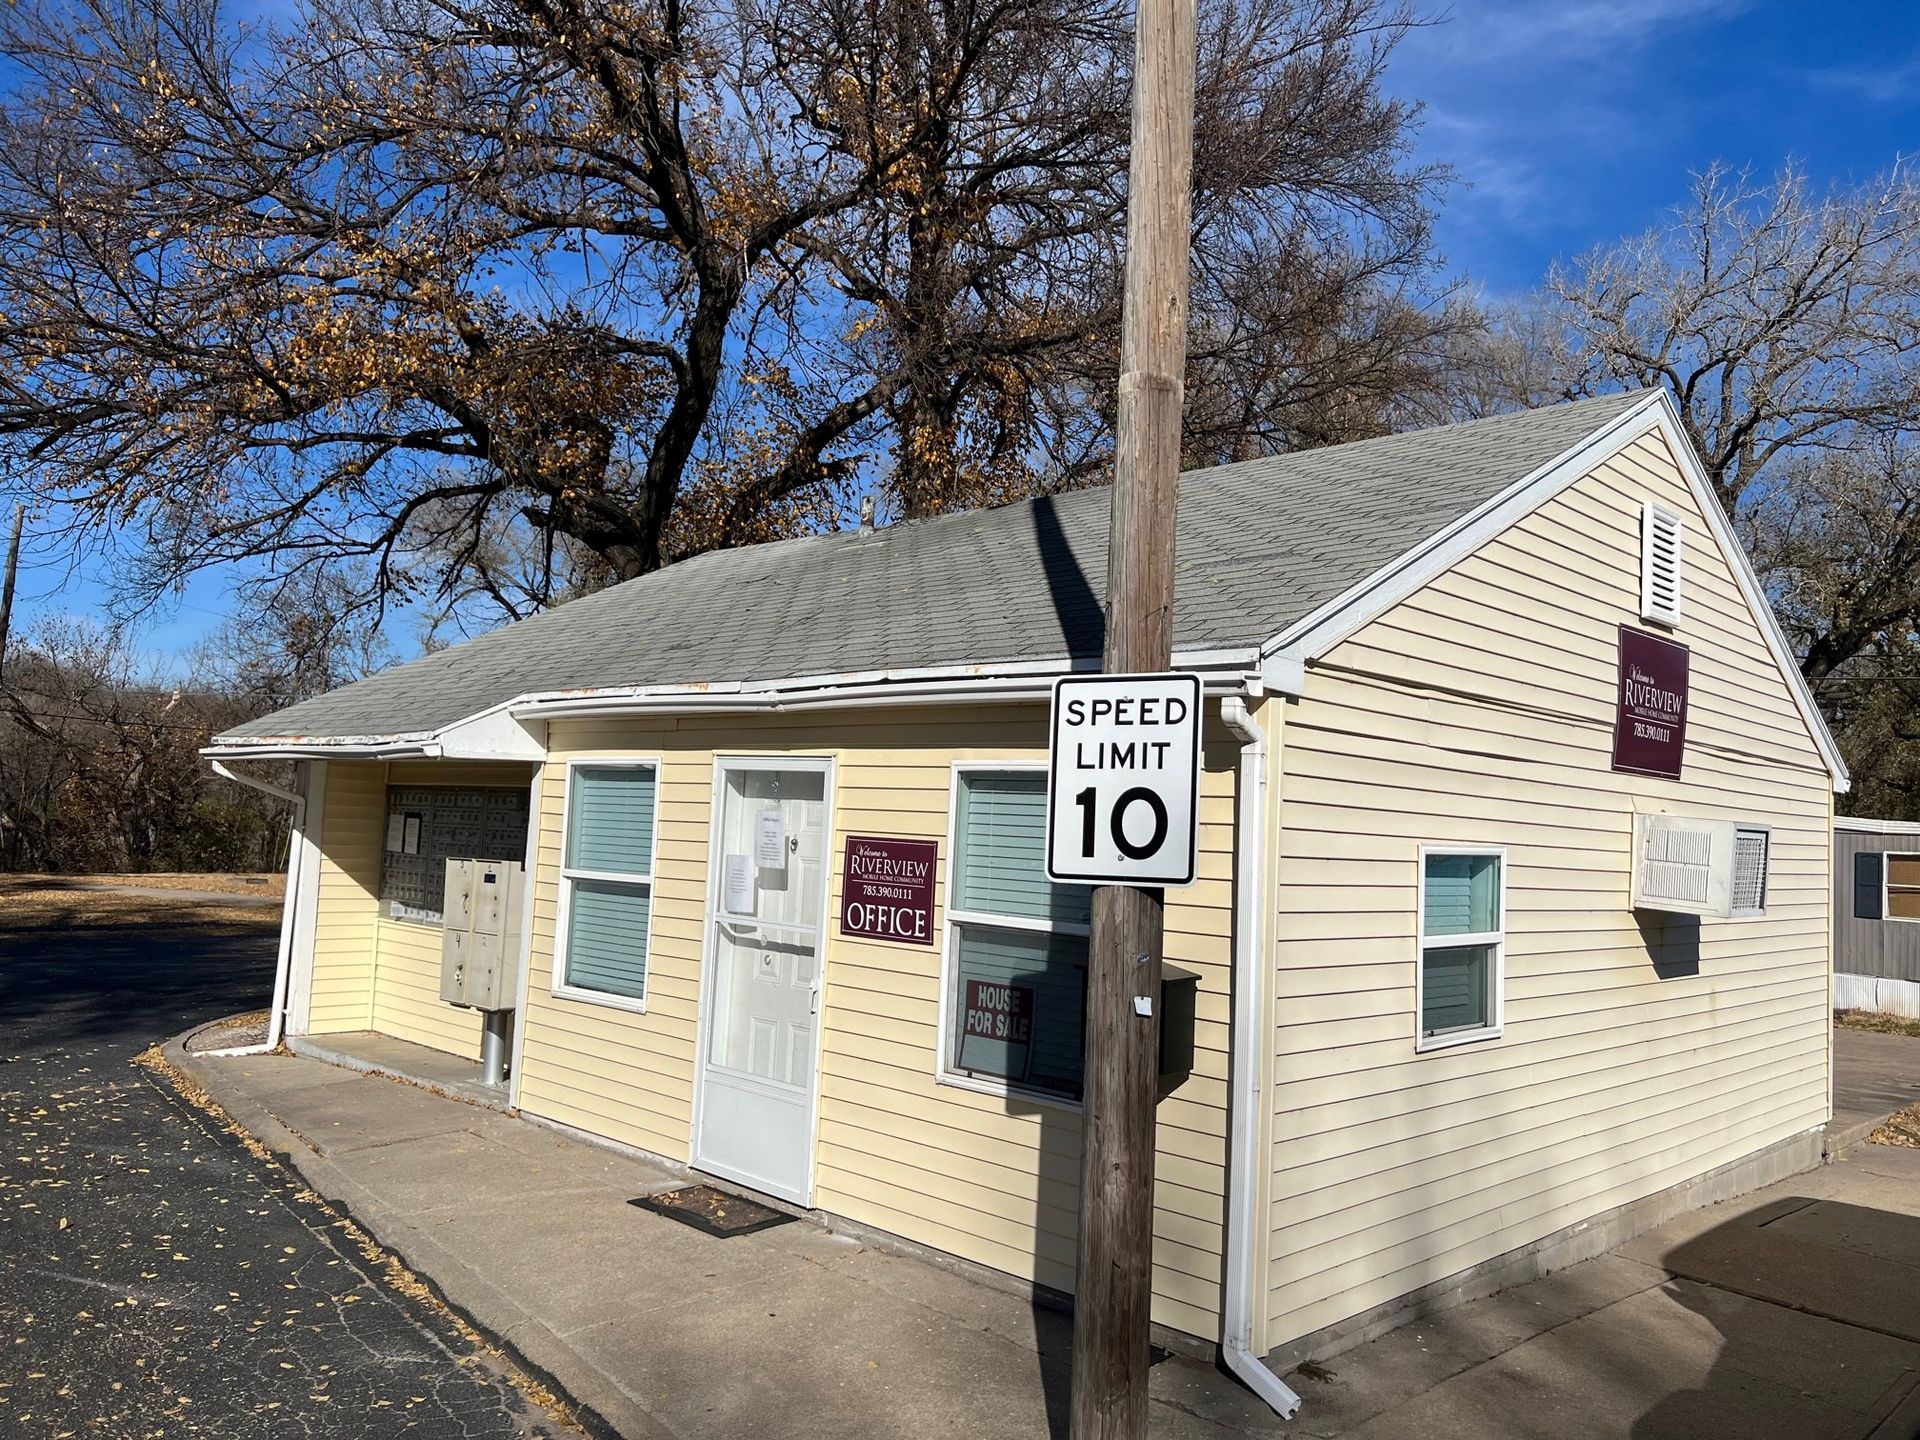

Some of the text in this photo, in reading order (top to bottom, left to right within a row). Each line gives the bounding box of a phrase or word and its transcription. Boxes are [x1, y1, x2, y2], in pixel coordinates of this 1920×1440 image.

[1625, 678, 1683, 714] RIVERVIEW
[1065, 697, 1187, 726] SPEED
[1634, 722, 1670, 742] 785.390.0111
[1076, 742, 1171, 770] LIMIT
[1075, 786, 1168, 860] 10
[856, 844, 881, 857] Welcome
[850, 855, 929, 878] RIVERVIEW
[893, 876, 925, 884] COMMUNITY
[863, 885, 912, 899] 785.390.0111
[847, 902, 926, 937] OFFICE
[977, 985, 1021, 1012] HOUSE
[967, 1009, 1028, 1041] FOR SALE
